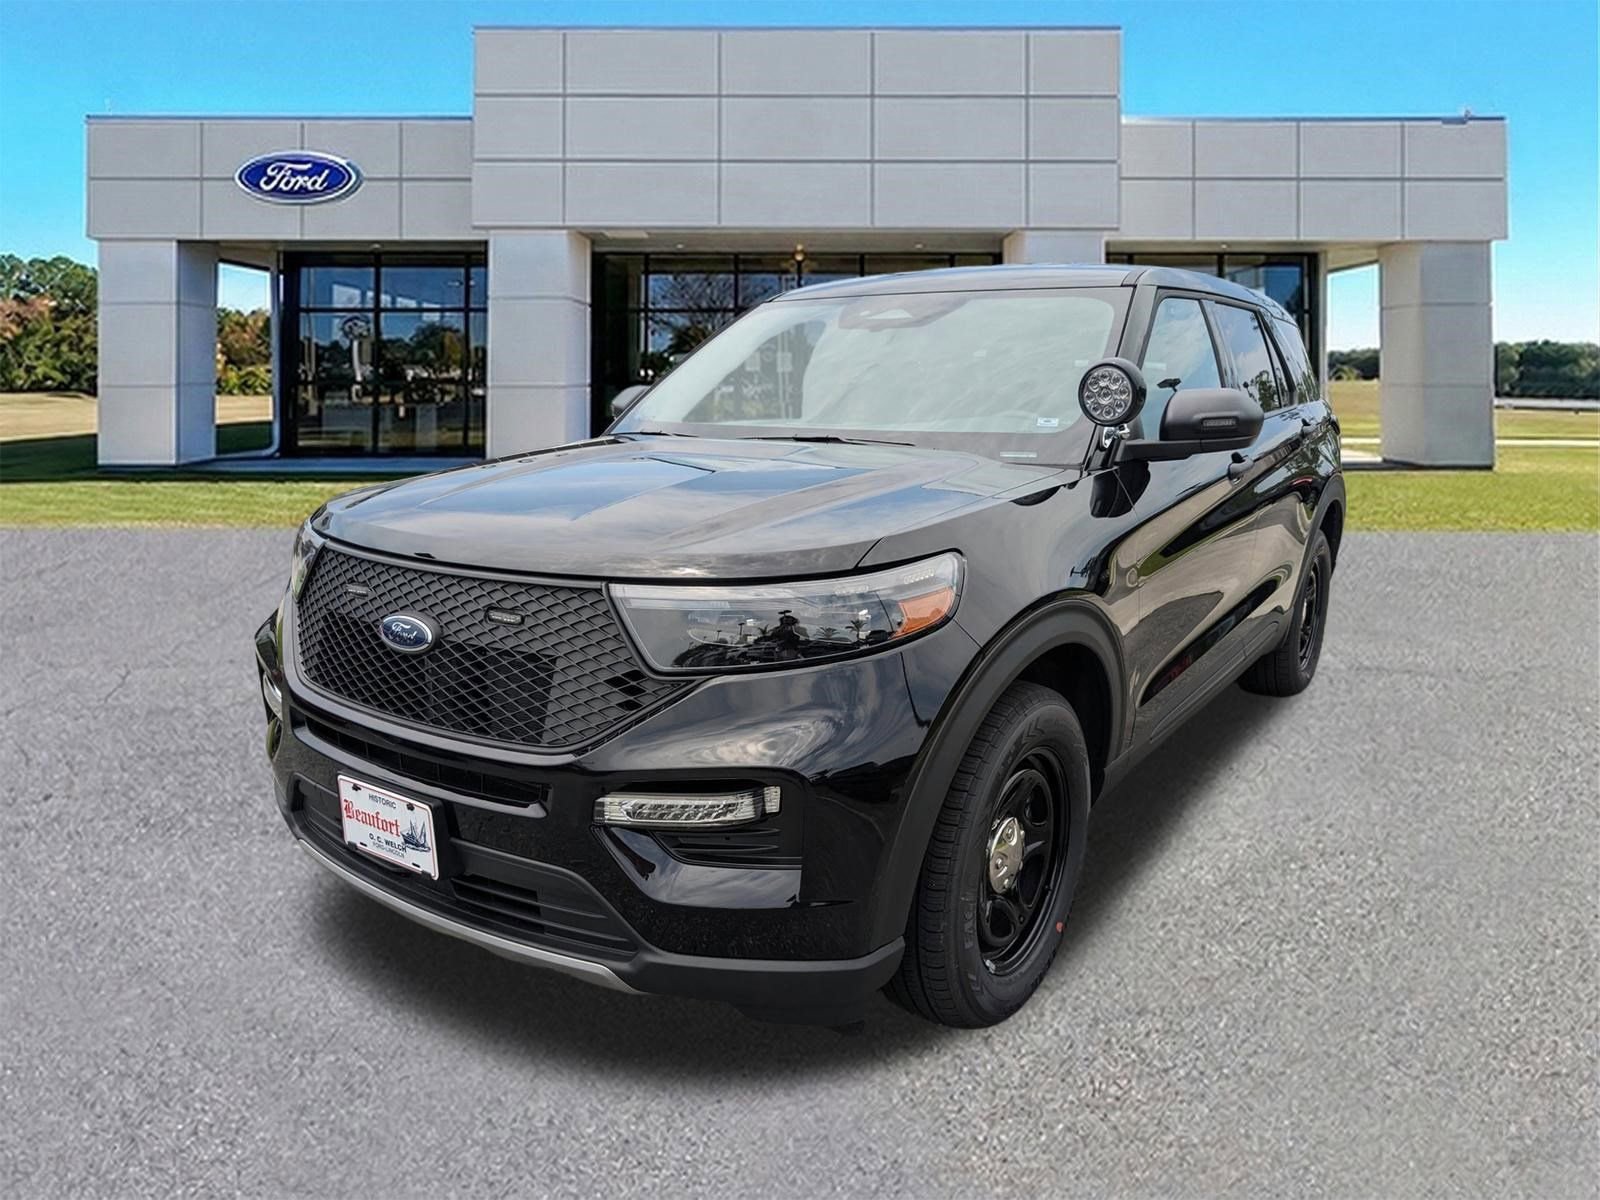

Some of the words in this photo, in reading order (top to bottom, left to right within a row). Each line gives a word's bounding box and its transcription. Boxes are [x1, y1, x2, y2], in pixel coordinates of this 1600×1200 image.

[259, 161, 330, 191] Ford
[368, 793, 397, 809] HISTORIC
[343, 799, 400, 838] Beaufort
[384, 838, 407, 853] WELCH
